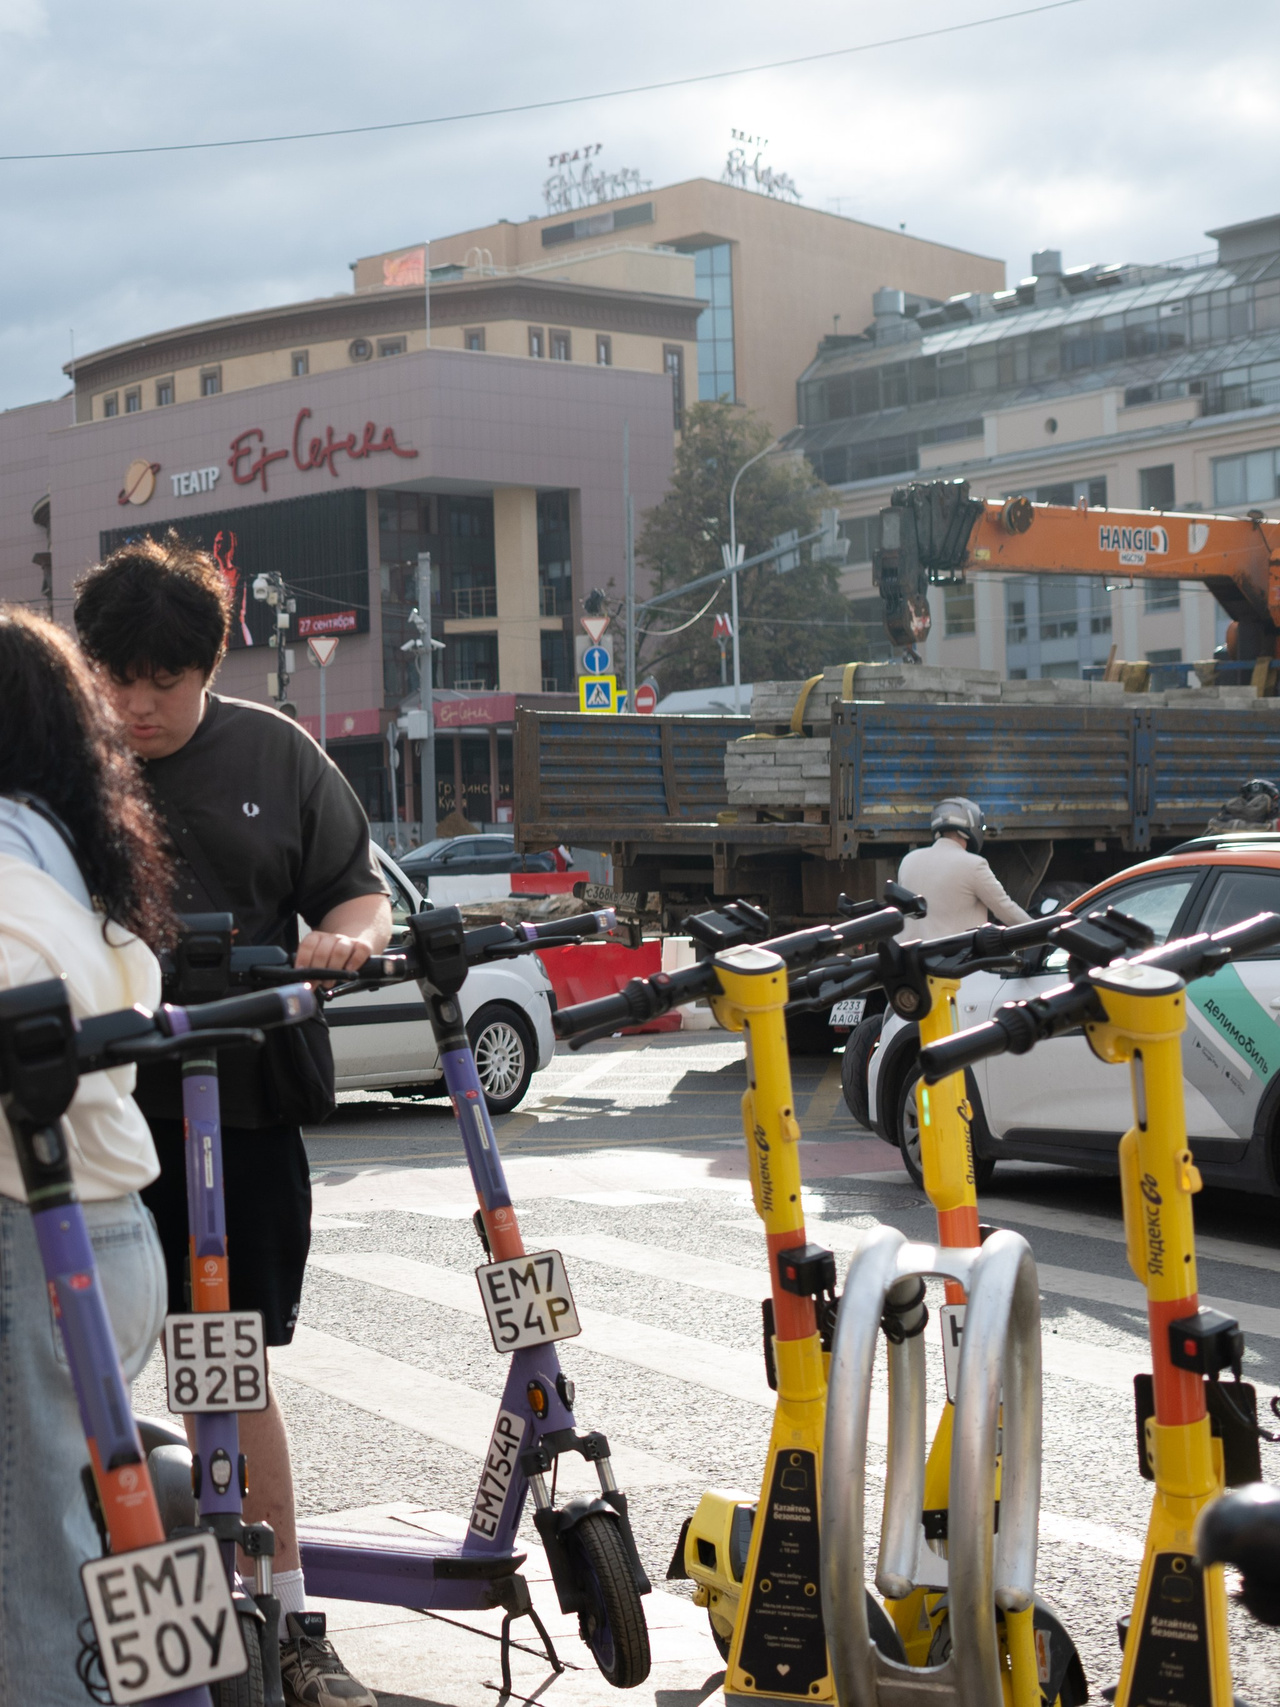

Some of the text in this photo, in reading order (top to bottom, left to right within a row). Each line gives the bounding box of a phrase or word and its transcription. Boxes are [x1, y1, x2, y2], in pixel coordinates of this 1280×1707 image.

[171, 466, 220, 497] ТЕАТР
[1100, 526, 1157, 551] HANGIL
[300, 615, 355, 633] 27 сентября
[438, 796, 467, 812] Кухя
[837, 1001, 861, 1011] 2233
[1204, 999, 1269, 1074] делимобиль
[759, 1151, 774, 1213] Яндекс
[1140, 1173, 1165, 1277] Яндекс Go
[486, 1256, 554, 1304] ЕМ7
[173, 1319, 258, 1360] ЕЕ5
[495, 1296, 570, 1343] 54Р
[174, 1364, 261, 1406] 82В
[471, 1416, 520, 1538] ЕМ754Р
[97, 1543, 207, 1625] ЕМ7
